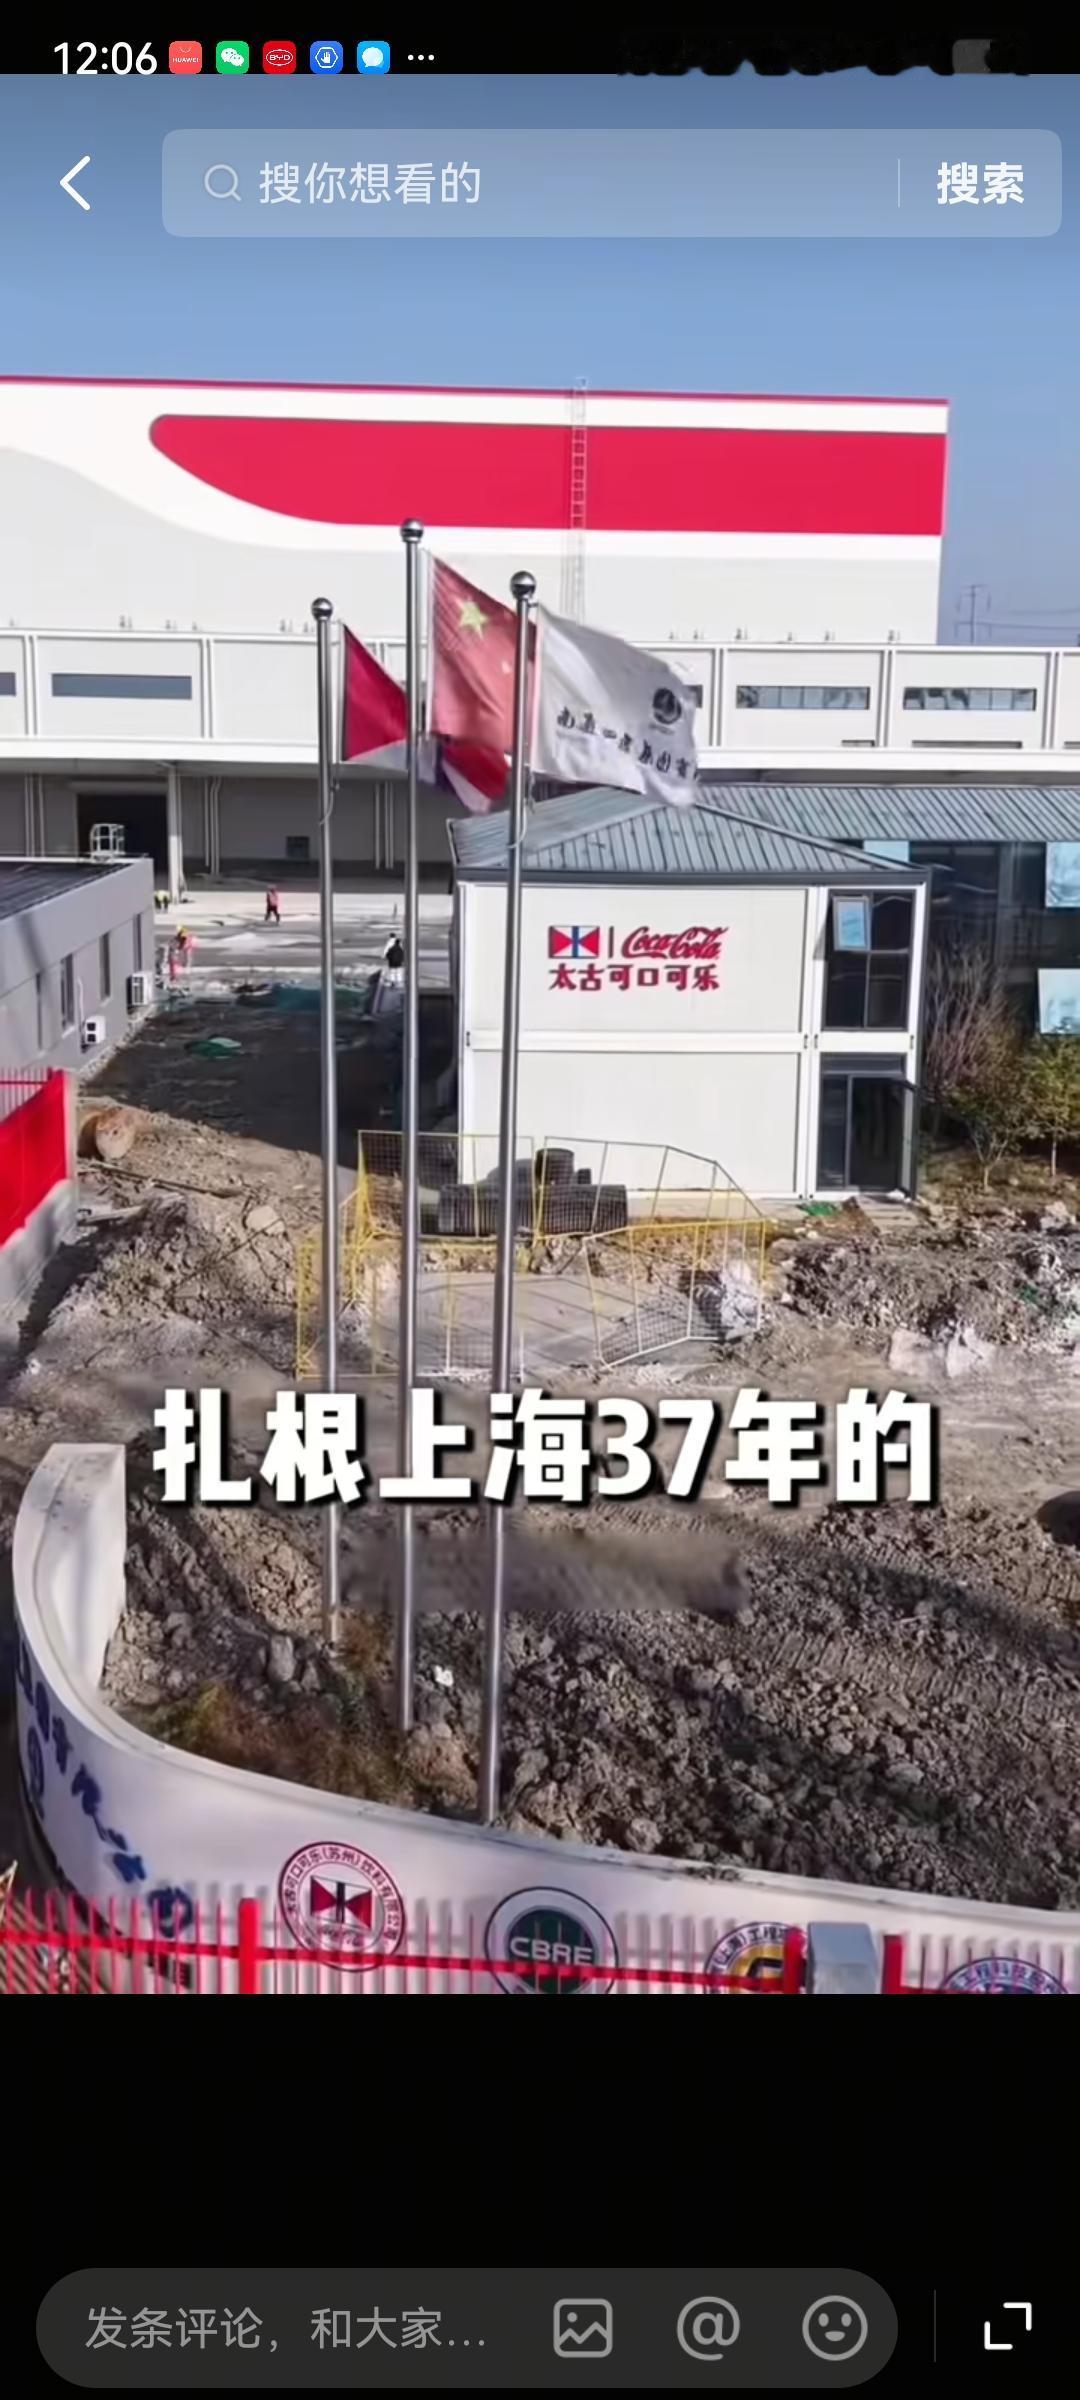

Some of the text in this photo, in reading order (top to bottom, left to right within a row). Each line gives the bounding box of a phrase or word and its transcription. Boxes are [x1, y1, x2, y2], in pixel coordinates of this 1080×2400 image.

[621, 926, 729, 960] Coca-Cola
[549, 962, 720, 992] 太古可口可乐
[509, 1936, 593, 1966] CBRE
